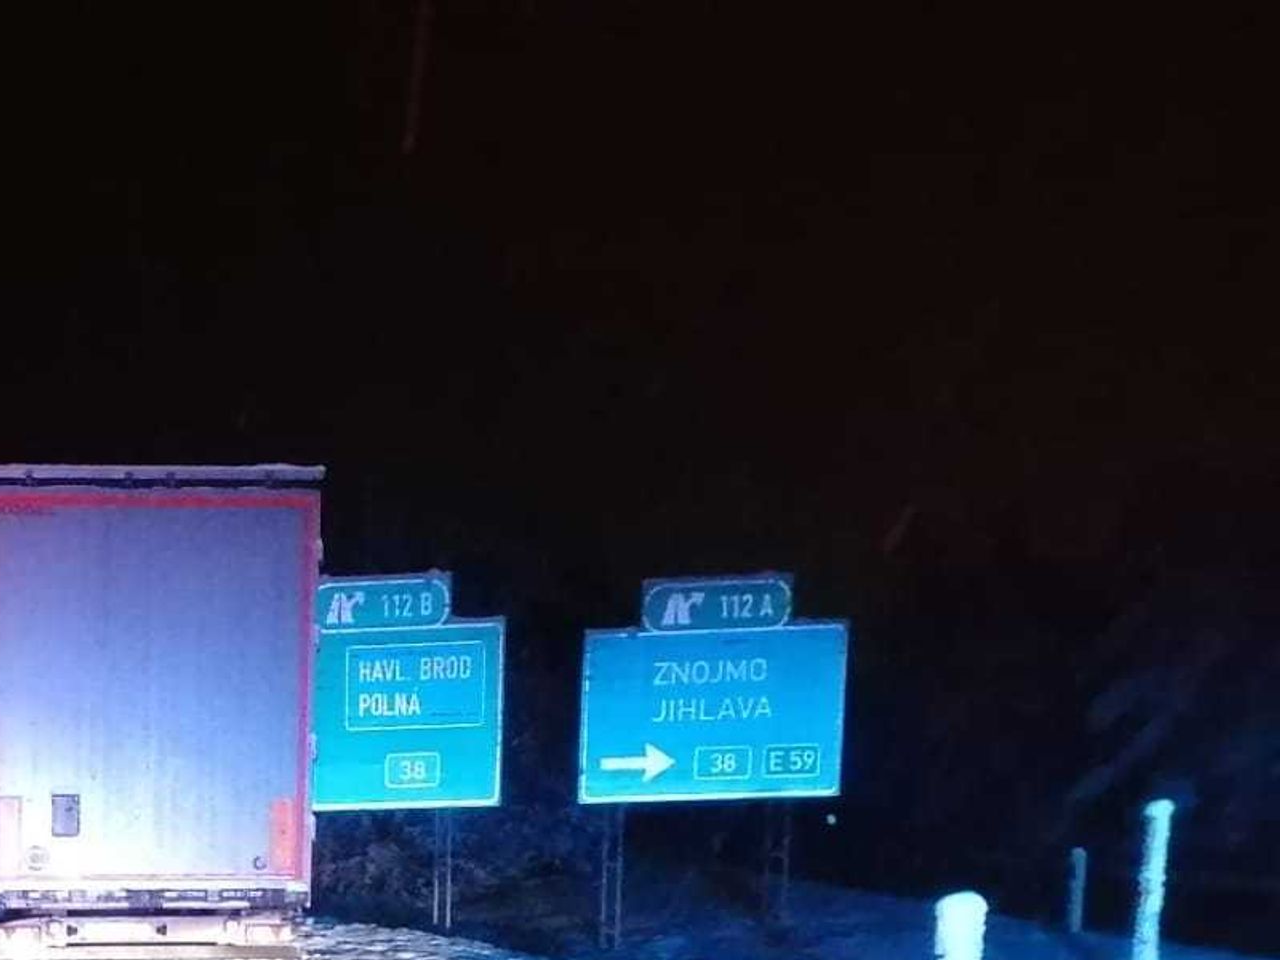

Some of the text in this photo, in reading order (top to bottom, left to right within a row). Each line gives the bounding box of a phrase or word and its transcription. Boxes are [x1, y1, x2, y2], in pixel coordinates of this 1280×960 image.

[381, 592, 433, 618] 112 B
[720, 593, 774, 618] 112 A
[420, 655, 472, 681] BROD
[652, 658, 768, 686] ZNOJMO
[358, 686, 421, 717] POLNÁ
[651, 697, 772, 722] JIHLAVA
[398, 760, 426, 780] 38
[709, 753, 736, 773] 38
[771, 751, 816, 771] E 59
